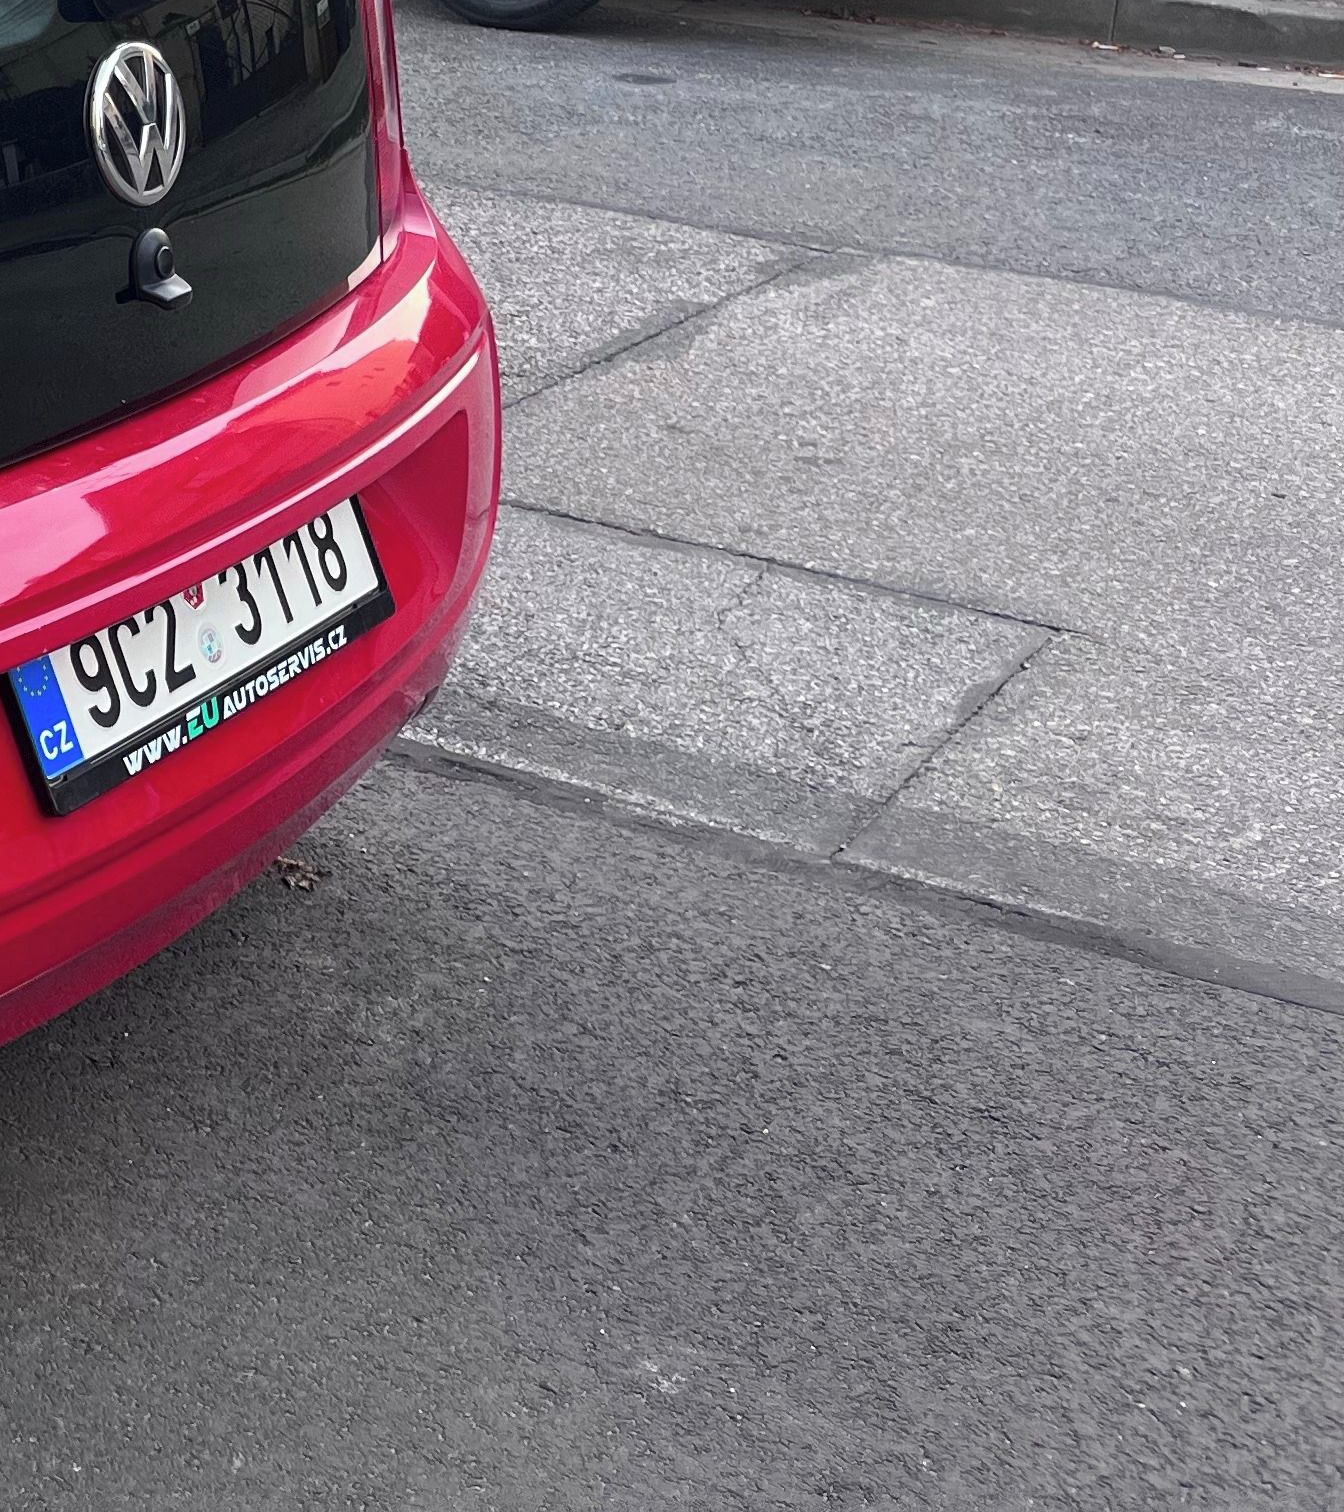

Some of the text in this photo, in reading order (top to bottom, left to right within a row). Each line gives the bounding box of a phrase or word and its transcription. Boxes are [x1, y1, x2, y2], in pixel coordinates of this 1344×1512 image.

[69, 513, 349, 730] 9C2 3118
[39, 720, 75, 761] CZ
